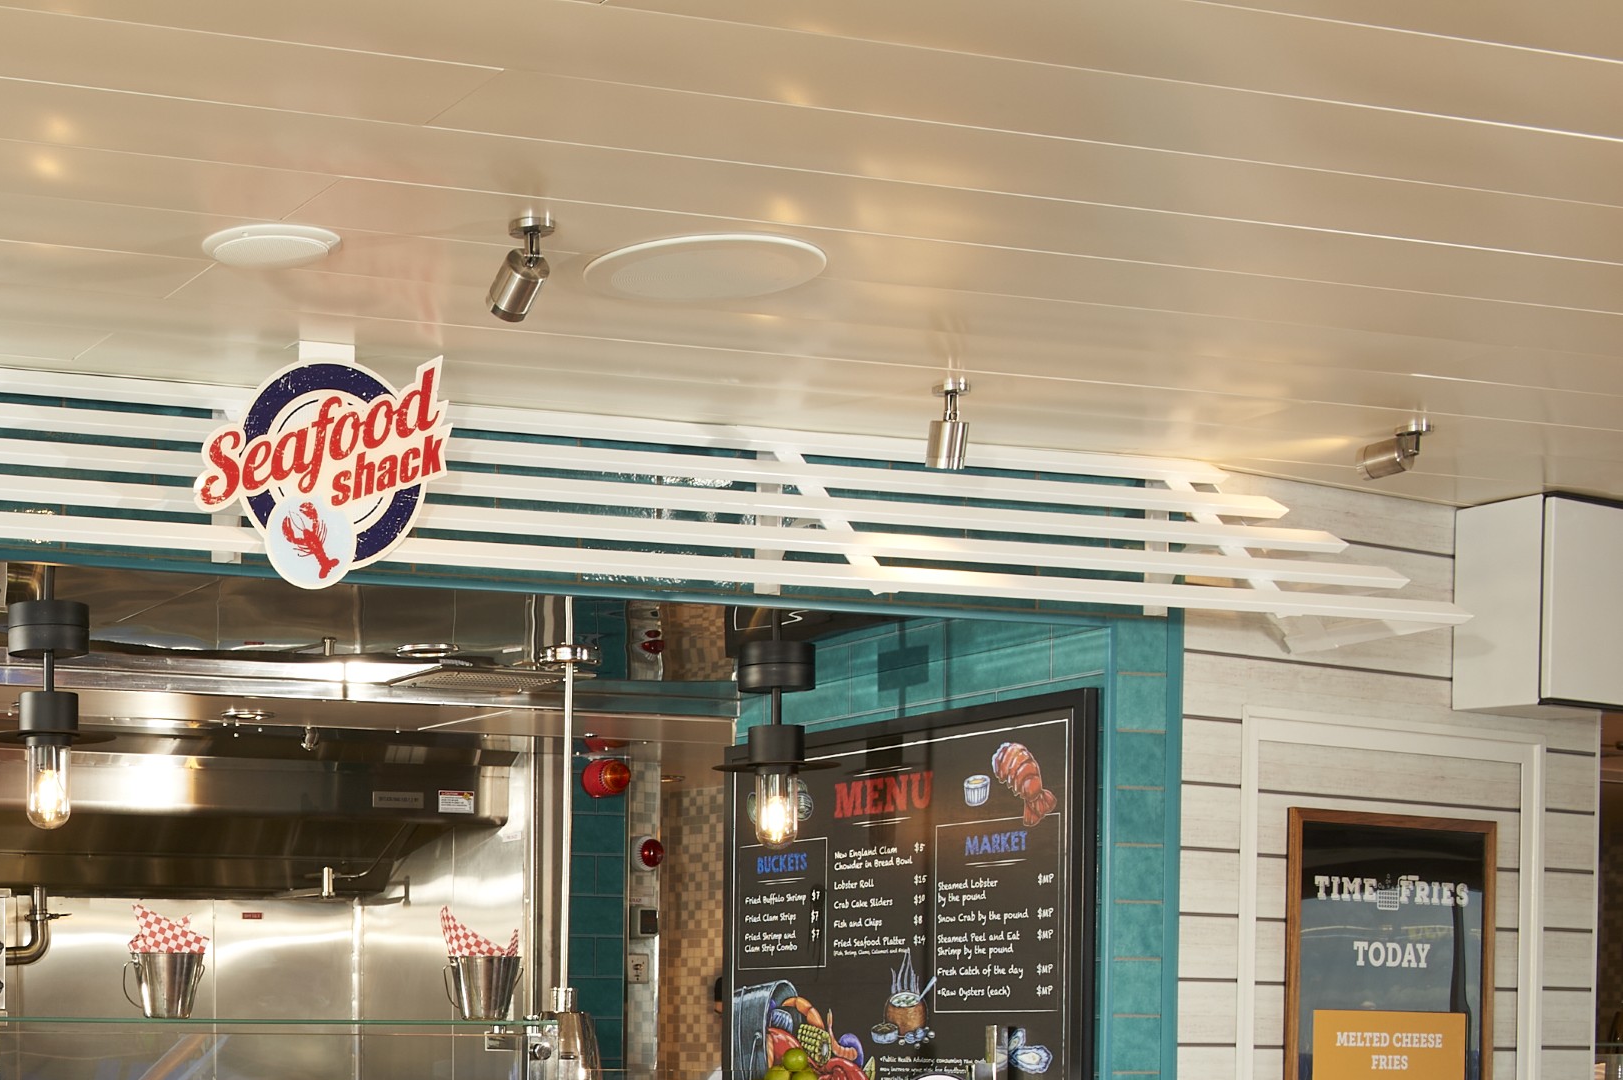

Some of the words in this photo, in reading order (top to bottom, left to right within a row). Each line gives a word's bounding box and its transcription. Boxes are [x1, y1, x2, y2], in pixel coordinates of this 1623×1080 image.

[200, 366, 440, 506] Seafood
[331, 435, 445, 507] shack
[834, 770, 933, 819] MENU
[834, 851, 848, 860] New
[849, 845, 877, 860] England
[879, 845, 898, 855] Clam
[914, 842, 926, 854] $5
[965, 830, 1027, 857] MARKET
[757, 852, 808, 874] BUCKETS
[834, 860, 863, 871] Chowder
[865, 860, 872, 868] in
[874, 857, 894, 868] Bread
[896, 855, 913, 866] Bowl
[834, 879, 858, 890] Lobster
[859, 878, 875, 889] Roll
[914, 873, 928, 886] $15
[938, 879, 968, 892] Steamed
[971, 877, 998, 889] Lobster
[1037, 873, 1054, 886] $MP
[745, 894, 761, 905] Fried
[763, 893, 784, 905] Buffalo
[786, 893, 807, 906] Shrimp
[812, 889, 820, 901] $7
[938, 892, 946, 907] by
[948, 893, 960, 902] the
[962, 889, 986, 906] pound
[1314, 875, 1377, 903] TIME
[1399, 878, 1470, 907] FRIES
[834, 898, 849, 909] Crab
[851, 899, 868, 908] Cake
[870, 896, 893, 908] Sliders
[745, 913, 761, 923] Fried
[763, 913, 778, 922] Clam
[780, 912, 797, 925] Strips
[811, 909, 819, 923] $7
[834, 919, 847, 928] Fish
[849, 917, 862, 928] and
[864, 918, 882, 931] Chips
[938, 914, 956, 924] Snow
[958, 910, 976, 922] Crab
[978, 910, 987, 926] by
[989, 910, 1002, 920] the
[1004, 908, 1029, 925] pound
[1037, 907, 1054, 920] $MP
[745, 932, 761, 941] Fried
[763, 932, 782, 944] Shrimp
[784, 930, 796, 939] and
[811, 928, 820, 941] $7
[834, 938, 852, 947] Fried
[853, 936, 881, 949] Seafood
[883, 936, 906, 946] Platter
[913, 934, 926, 946] $14
[937, 932, 968, 944] Steamed
[970, 932, 986, 942] Peel
[989, 930, 1005, 940] and
[1007, 930, 1020, 940] Eat
[1037, 929, 1054, 941] $MP
[745, 944, 760, 953] Clam
[762, 944, 775, 956] Strip
[777, 941, 798, 951] Combo
[937, 947, 962, 960] Shrimp
[964, 944, 972, 960] by
[974, 945, 987, 955] the
[989, 943, 1014, 959] pound
[1353, 941, 1431, 968] TODAY
[937, 967, 957, 976] Fresh
[959, 966, 980, 976] Catch
[982, 964, 992, 977] of
[994, 965, 1006, 975] the
[1008, 964, 1024, 979] day
[1037, 963, 1053, 976] $MP
[958, 987, 985, 1001] Oysters
[987, 985, 1011, 998] (each)
[1036, 984, 1053, 997] $MP
[1336, 1031, 1390, 1047] MELTED
[1393, 1032, 1443, 1048] CHEESE
[1371, 1055, 1409, 1070] FRIES
